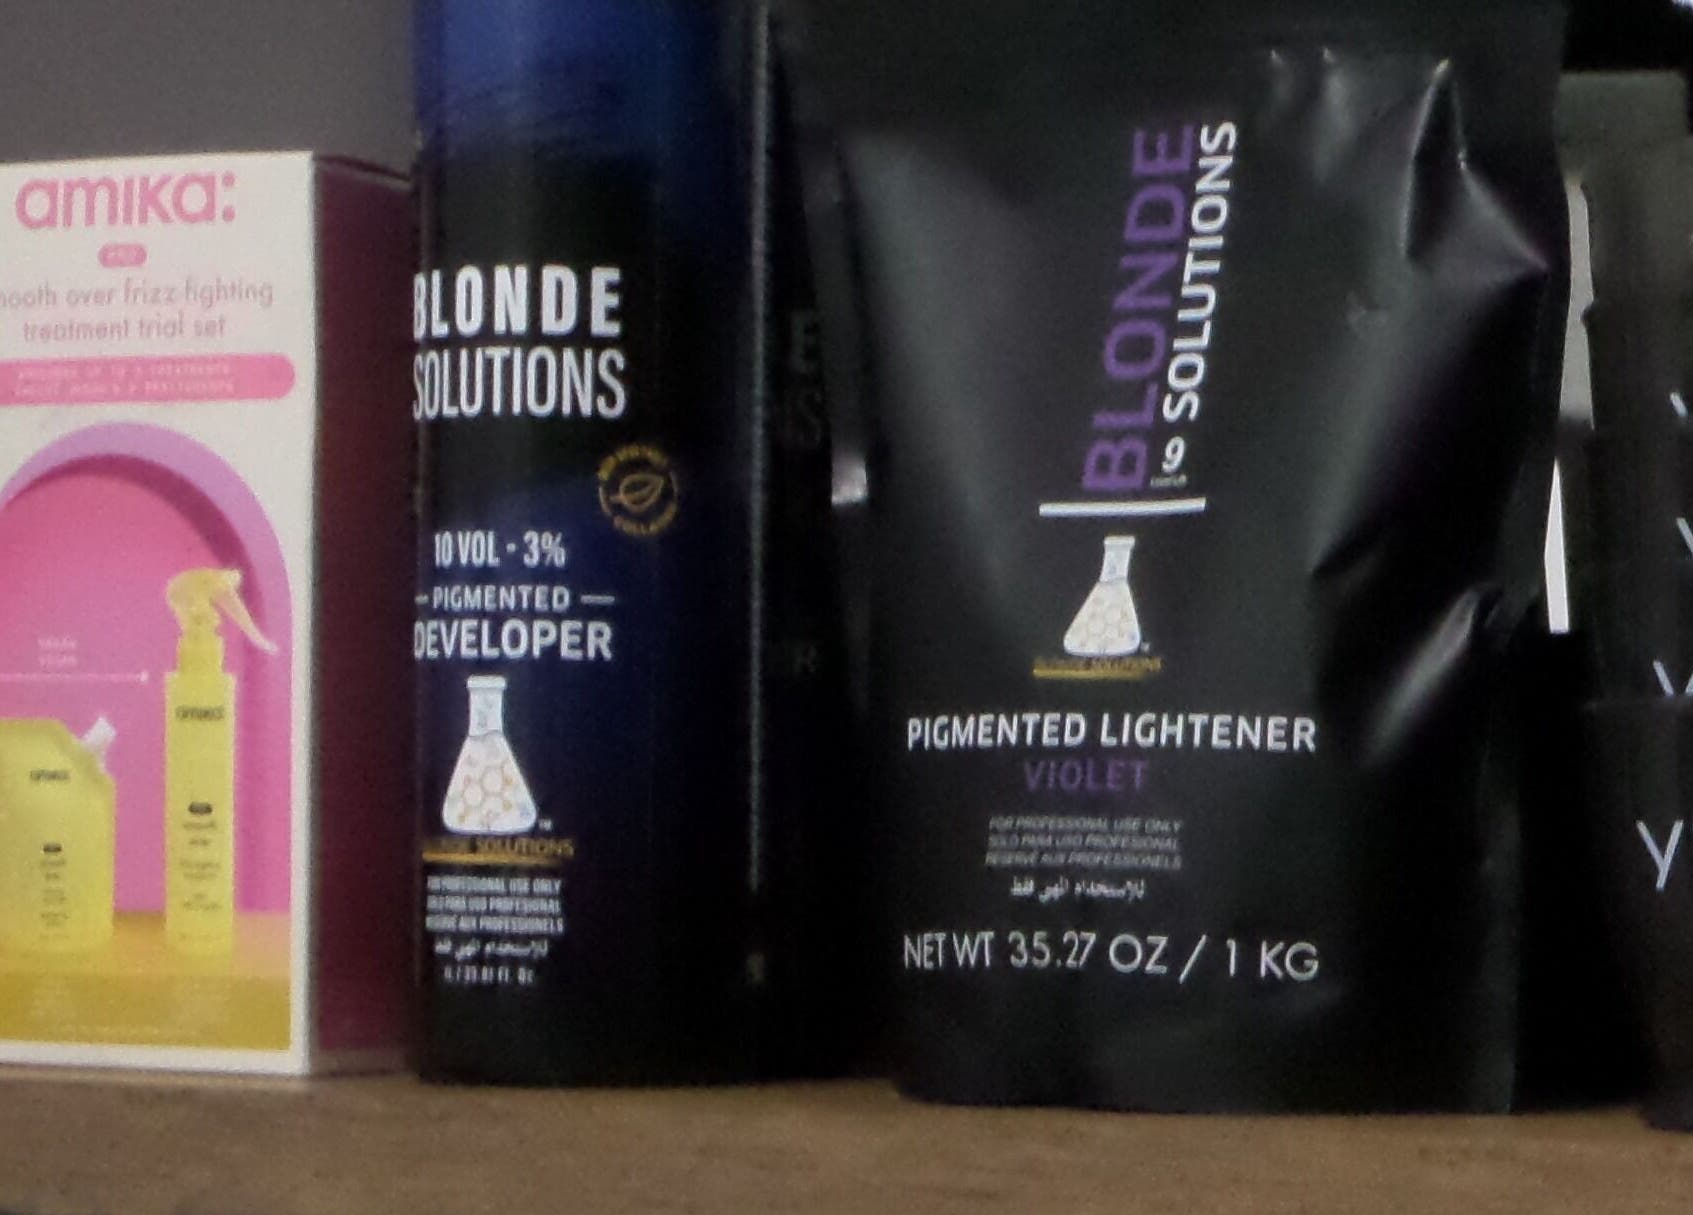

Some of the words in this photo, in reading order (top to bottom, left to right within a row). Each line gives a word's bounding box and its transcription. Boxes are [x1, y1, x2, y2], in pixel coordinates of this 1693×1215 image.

[1162, 120, 1238, 423] SOLUTIONS
[413, 264, 622, 341] BLONDE
[1081, 122, 1194, 491] BLONDE
[413, 346, 627, 422] SOLUTIONS
[458, 530, 499, 568] VOL
[523, 530, 567, 569] 3%
[432, 584, 570, 613] PIGMENTED
[413, 618, 614, 661] DEVELOPER
[907, 712, 1087, 751] PIGMENTED
[1099, 712, 1317, 753] LIGHTENER
[1023, 759, 1149, 792] VIOLET
[903, 932, 947, 970] NET
[953, 932, 995, 968] WT
[1008, 931, 1097, 968] 35.27
[1108, 934, 1170, 975] OZ
[1259, 941, 1320, 981] KG
